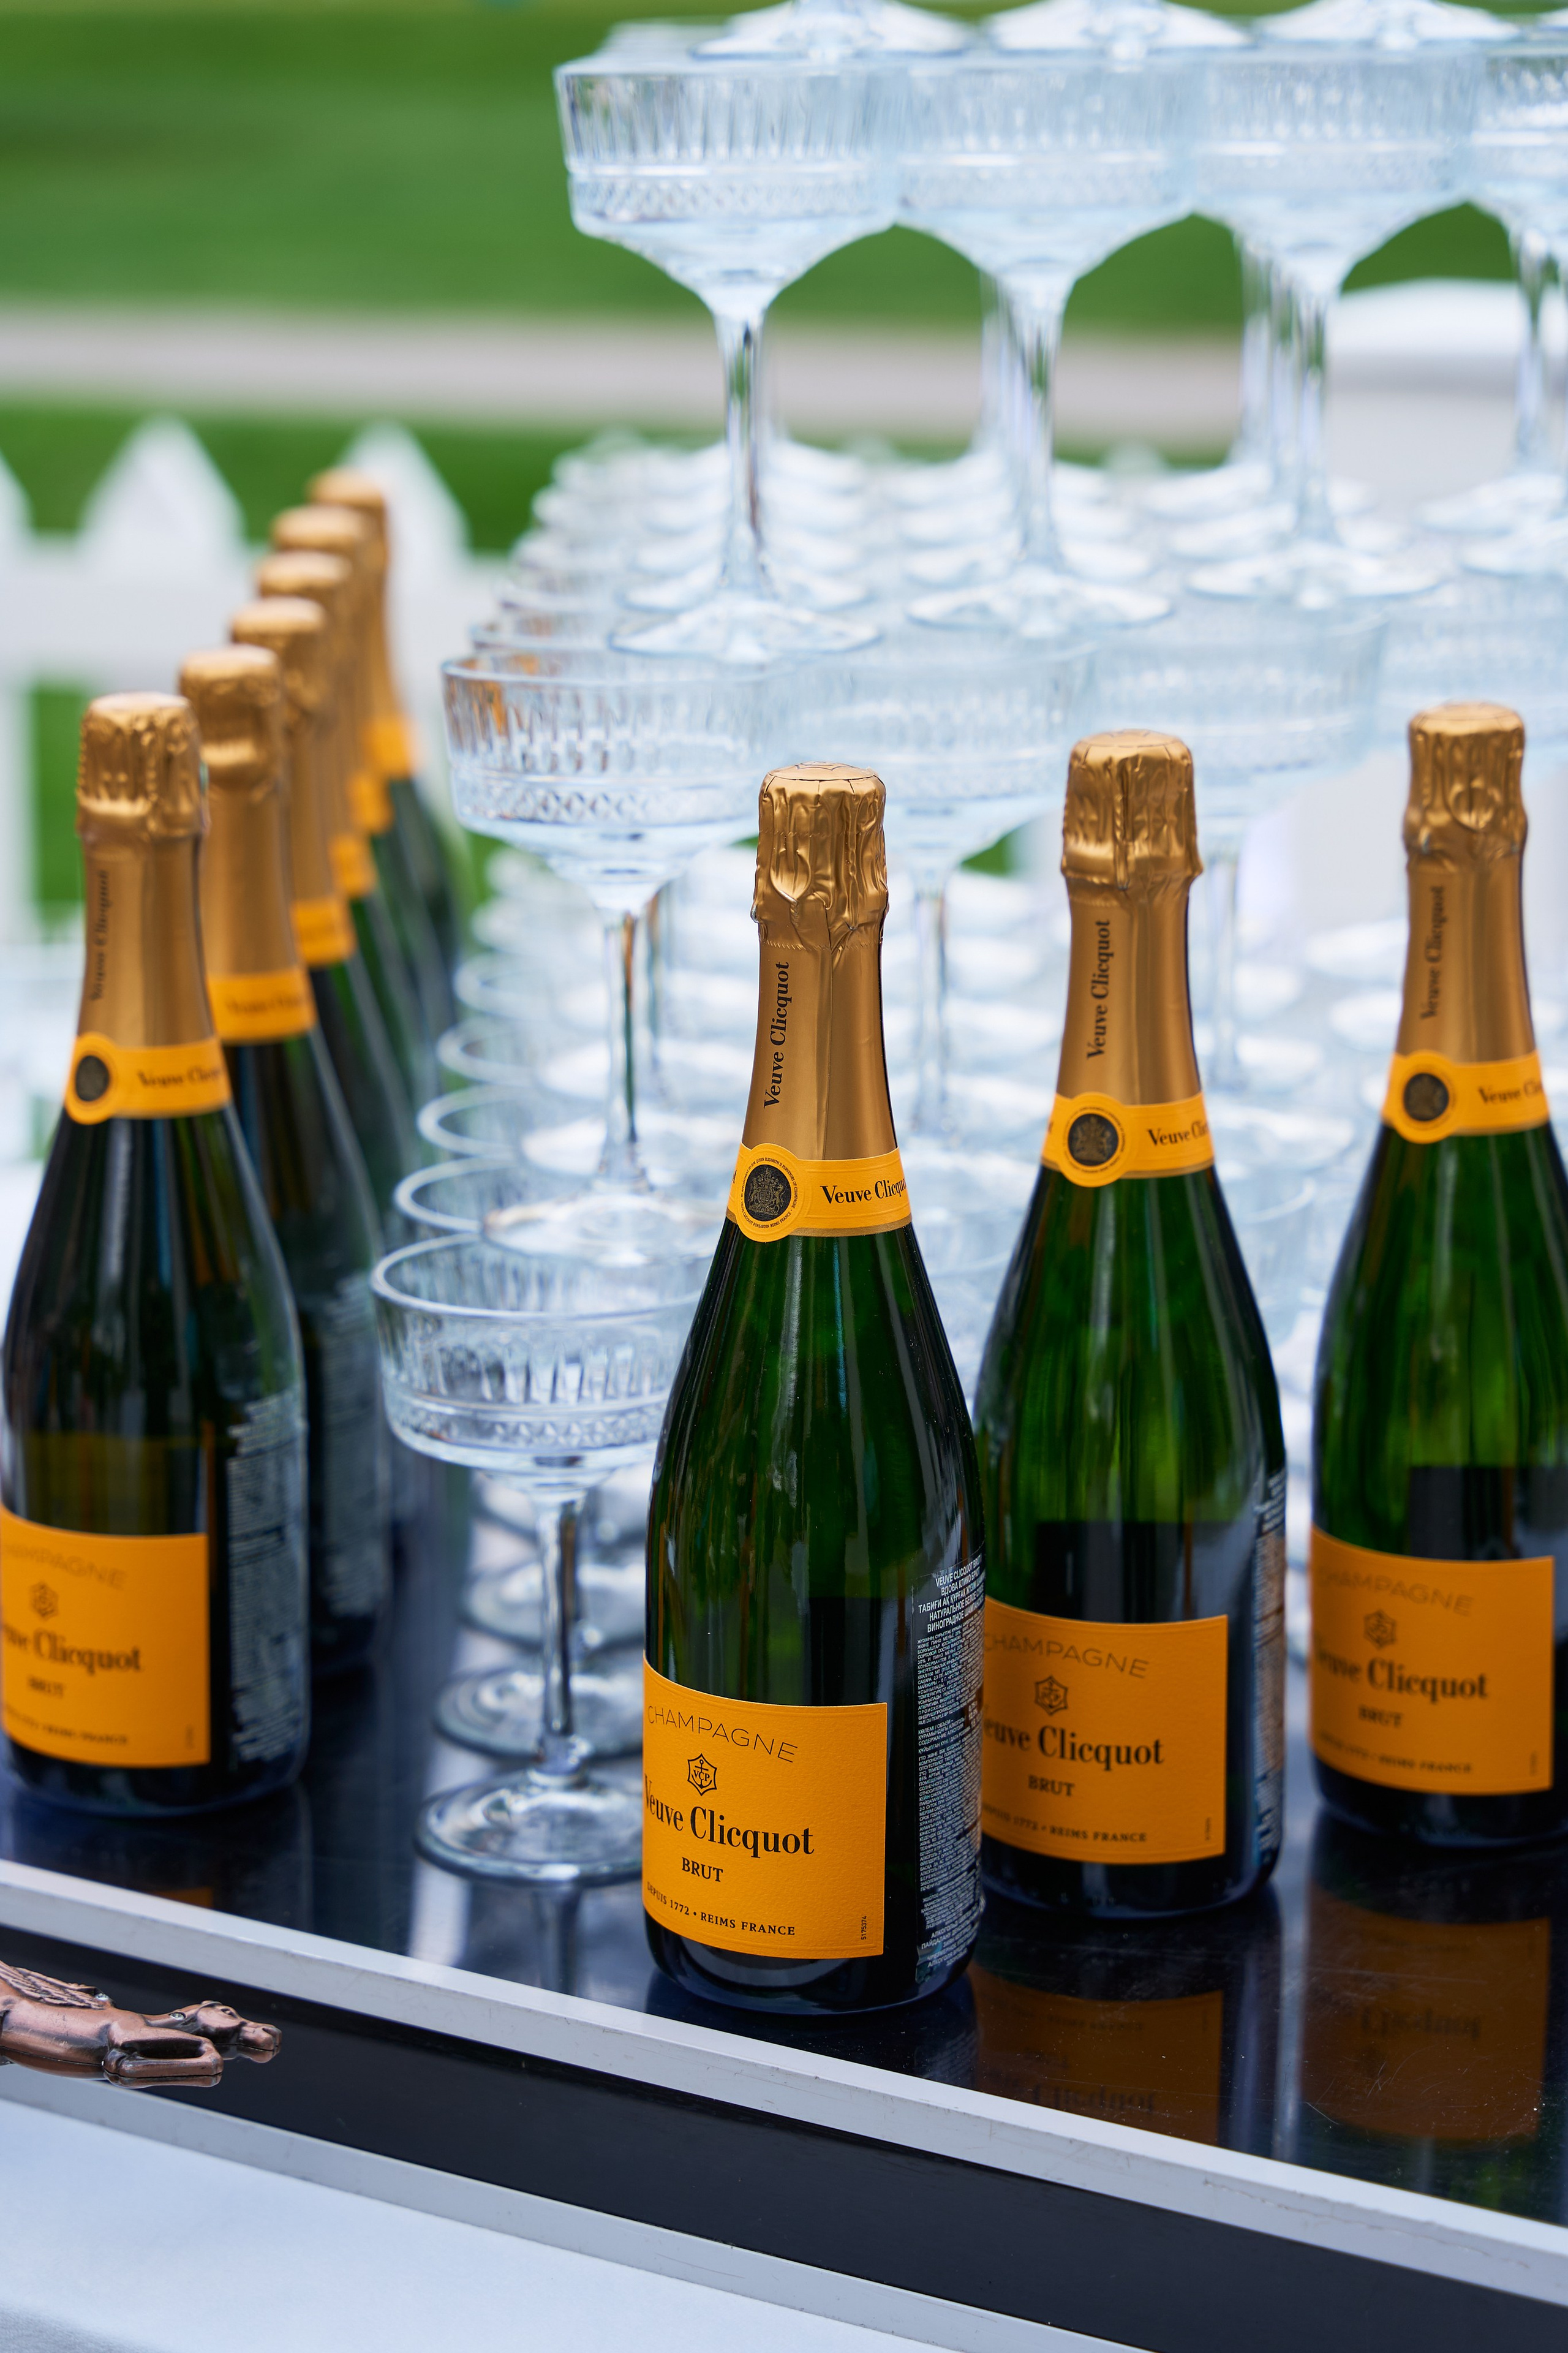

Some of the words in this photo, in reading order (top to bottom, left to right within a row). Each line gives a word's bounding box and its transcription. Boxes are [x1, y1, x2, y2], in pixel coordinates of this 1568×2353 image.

[1090, 920, 1114, 1000] Clicquot
[770, 961, 793, 1046] Clicquot
[1087, 1004, 1107, 1059] Veuve
[763, 1051, 784, 1109] Veuve
[1147, 1128, 1191, 1146] Veuve
[782, 1165, 796, 1182] PURVEYORS
[820, 1185, 872, 1204] Veuve
[780, 1212, 791, 1223] FRANCE
[935, 1573, 953, 1587] VEUVE
[954, 1562, 973, 1581] CLICQUOT
[941, 1583, 958, 1596] ВДОВА
[927, 1610, 964, 1633] ВИНОГРАДНОЕ
[929, 1600, 965, 1622] НАТУРАЛЬНОЕ
[32, 1630, 142, 1676] Clicquot
[1368, 1657, 1489, 1704] Clicquot
[1358, 1705, 1403, 1728] BRUT
[647, 1705, 797, 1763] CHAMPAGNE
[918, 1732, 947, 1746] СОДЕРЖАНИЕ
[982, 1703, 1031, 1752] euve
[1039, 1724, 1164, 1772] Clicquot
[693, 1769, 710, 1781] VCP
[1028, 1775, 1076, 1797] BRUT
[644, 1773, 684, 1832] Veuve
[690, 1805, 815, 1859] Clicquot
[1049, 1823, 1090, 1840] REIMS
[1093, 1830, 1147, 1843] FRANCE
[681, 1857, 724, 1883] BRUT
[647, 1881, 668, 1905] DEPUIS
[670, 1899, 690, 1916] 1772
[701, 1911, 736, 1928] REIMS
[741, 1921, 796, 1936] FRANCE
